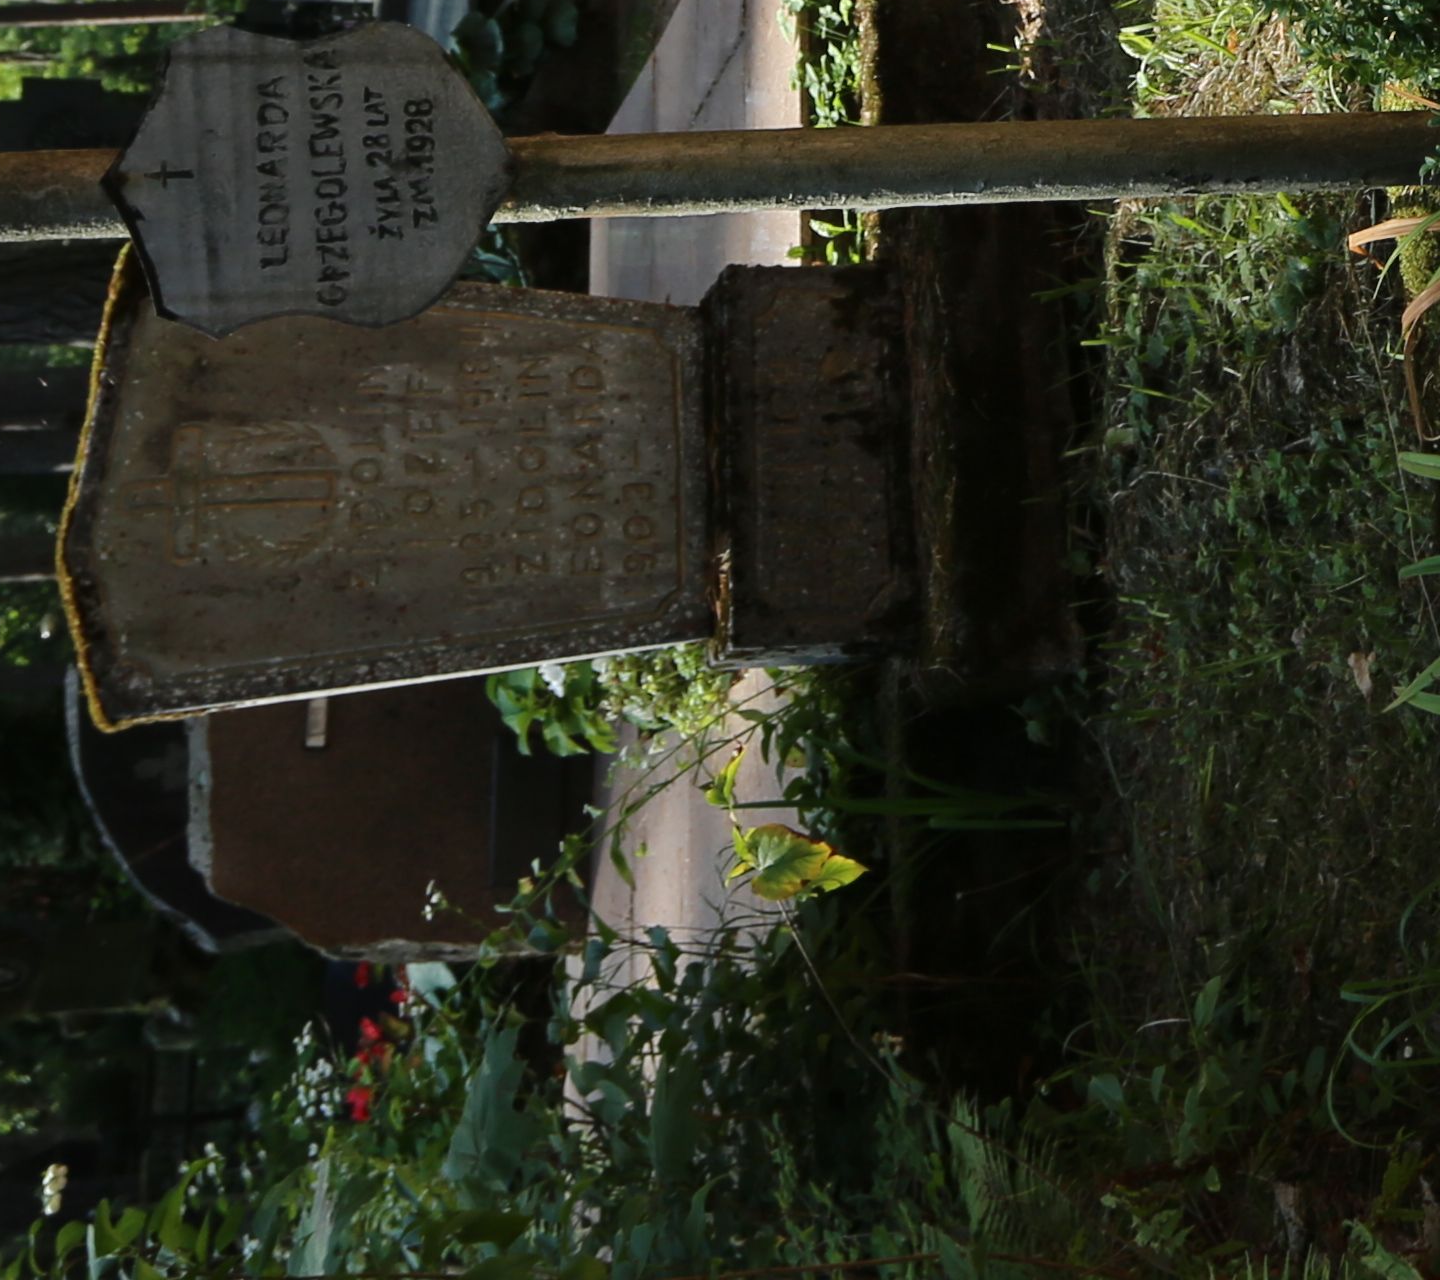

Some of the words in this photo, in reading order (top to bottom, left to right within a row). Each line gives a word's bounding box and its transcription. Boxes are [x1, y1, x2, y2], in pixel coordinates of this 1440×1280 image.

[361, 133, 392, 168] 28
[362, 86, 391, 128] LAT
[254, 75, 290, 270] LEONARDA
[514, 351, 551, 576] ZIDOLIN
